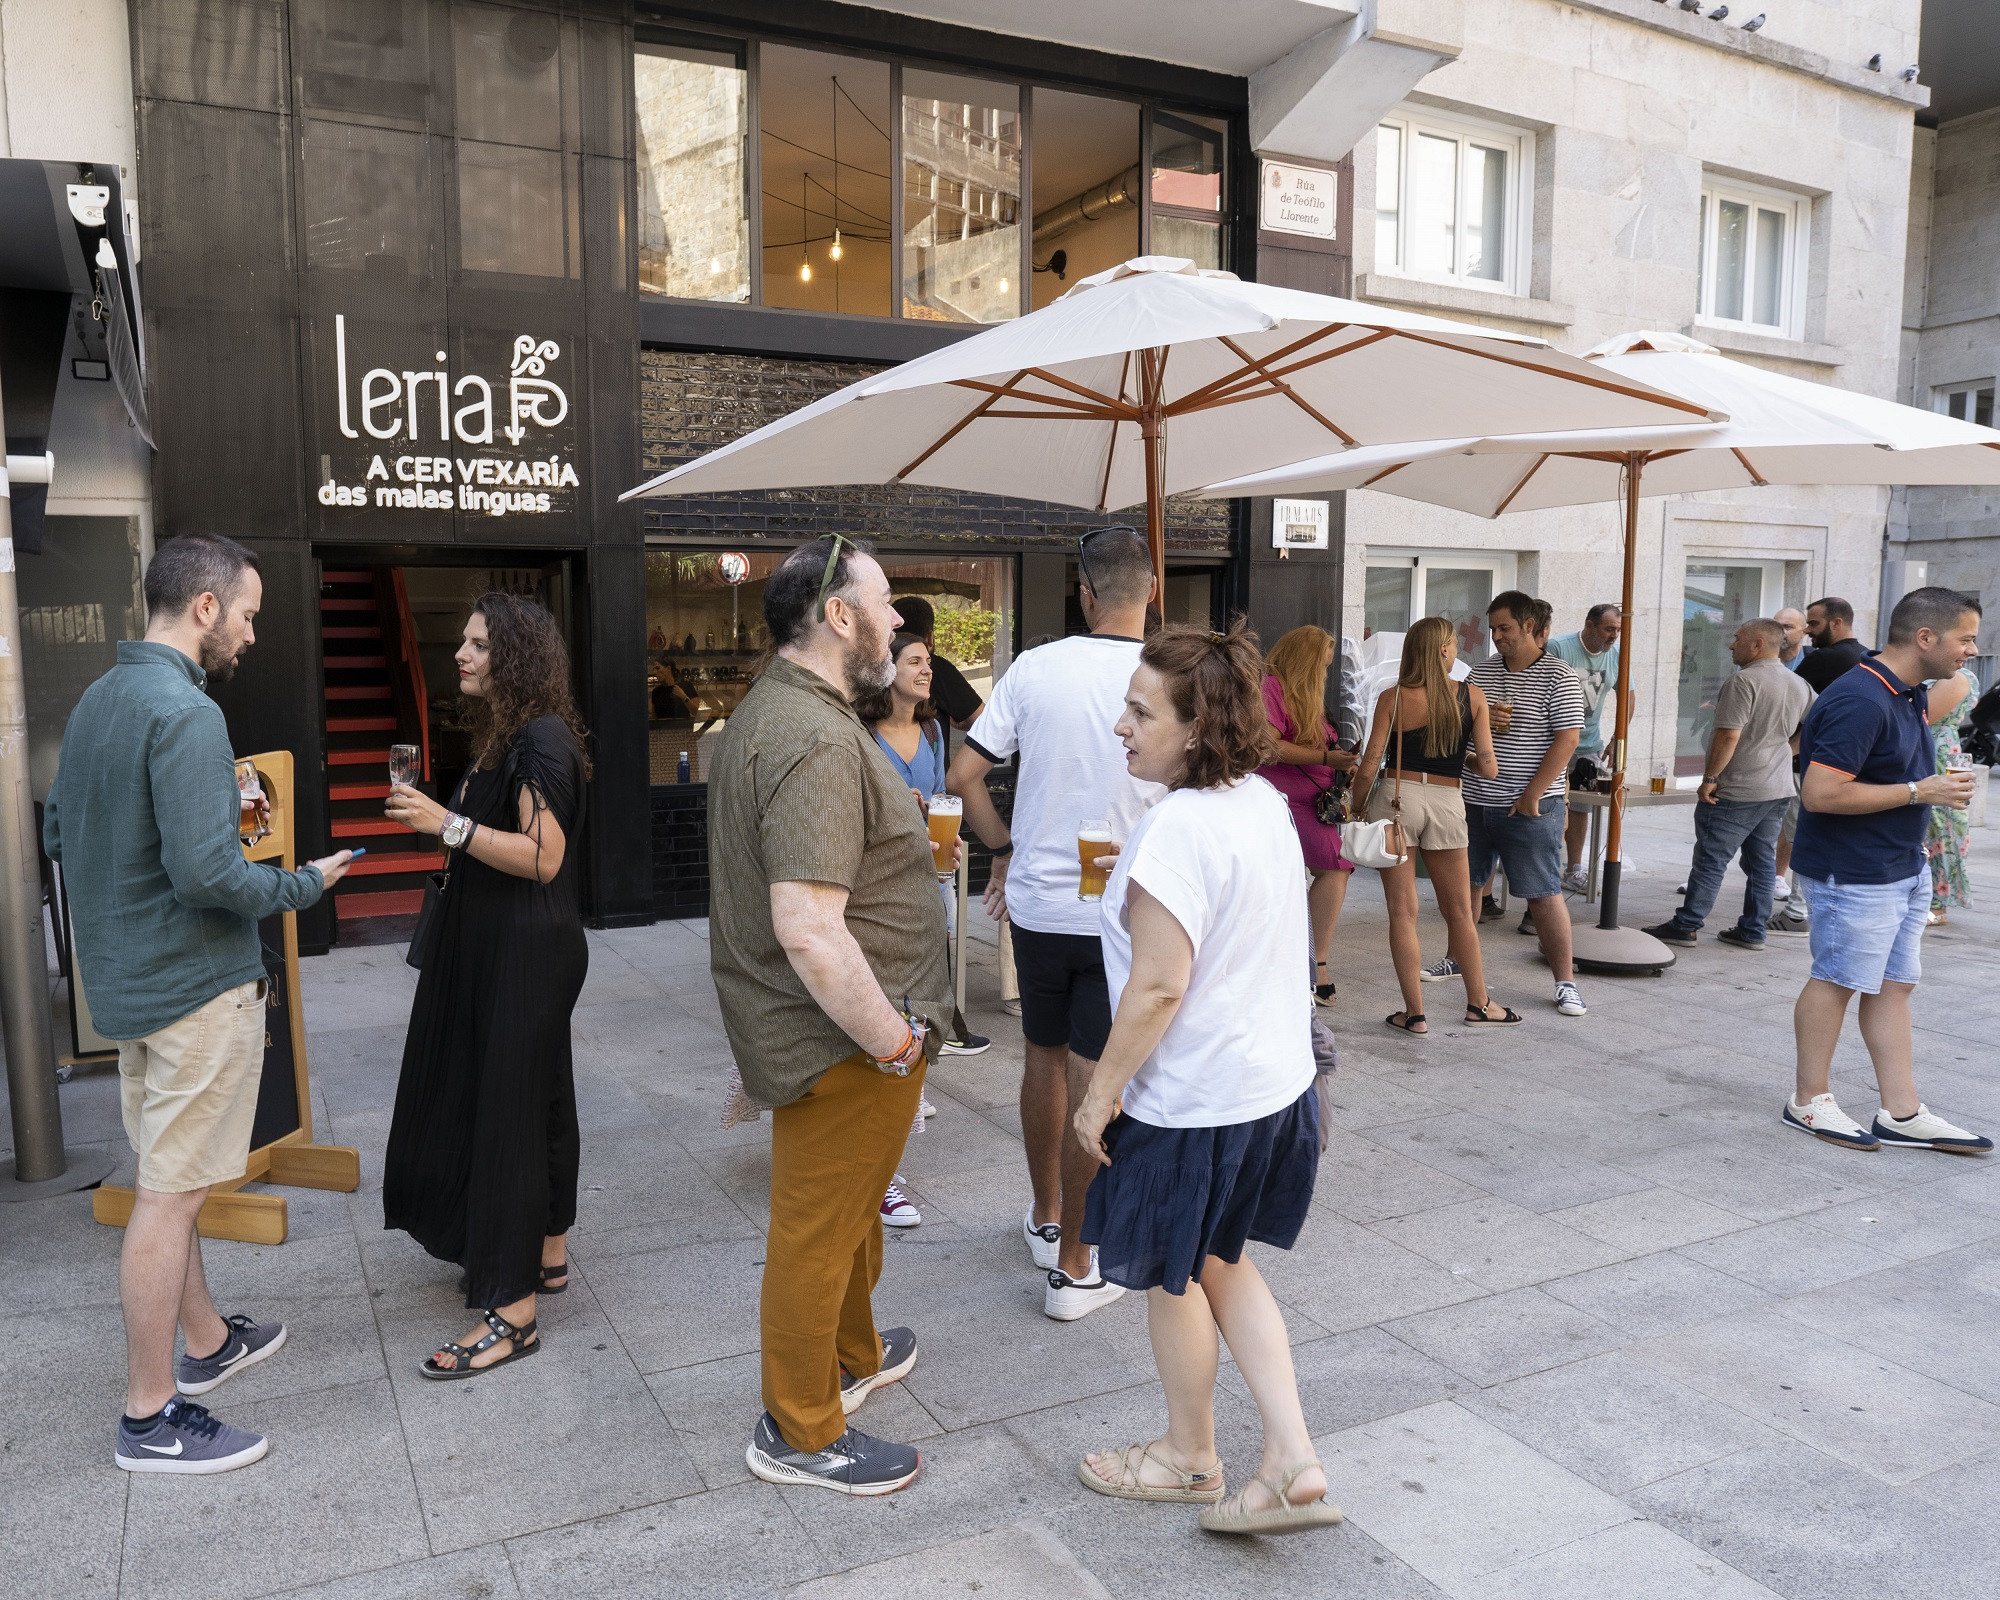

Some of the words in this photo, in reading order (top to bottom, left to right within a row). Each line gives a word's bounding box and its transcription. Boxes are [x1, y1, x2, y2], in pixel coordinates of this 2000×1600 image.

[1296, 178, 1315, 191] Rúa
[1280, 192, 1292, 203] de
[1293, 194, 1325, 209] Teófilo
[1280, 209, 1319, 224] Llorente
[335, 314, 493, 444] leria
[366, 454, 389, 481] A
[318, 479, 368, 507] das
[375, 482, 454, 509] malas
[458, 484, 551, 516] linguas
